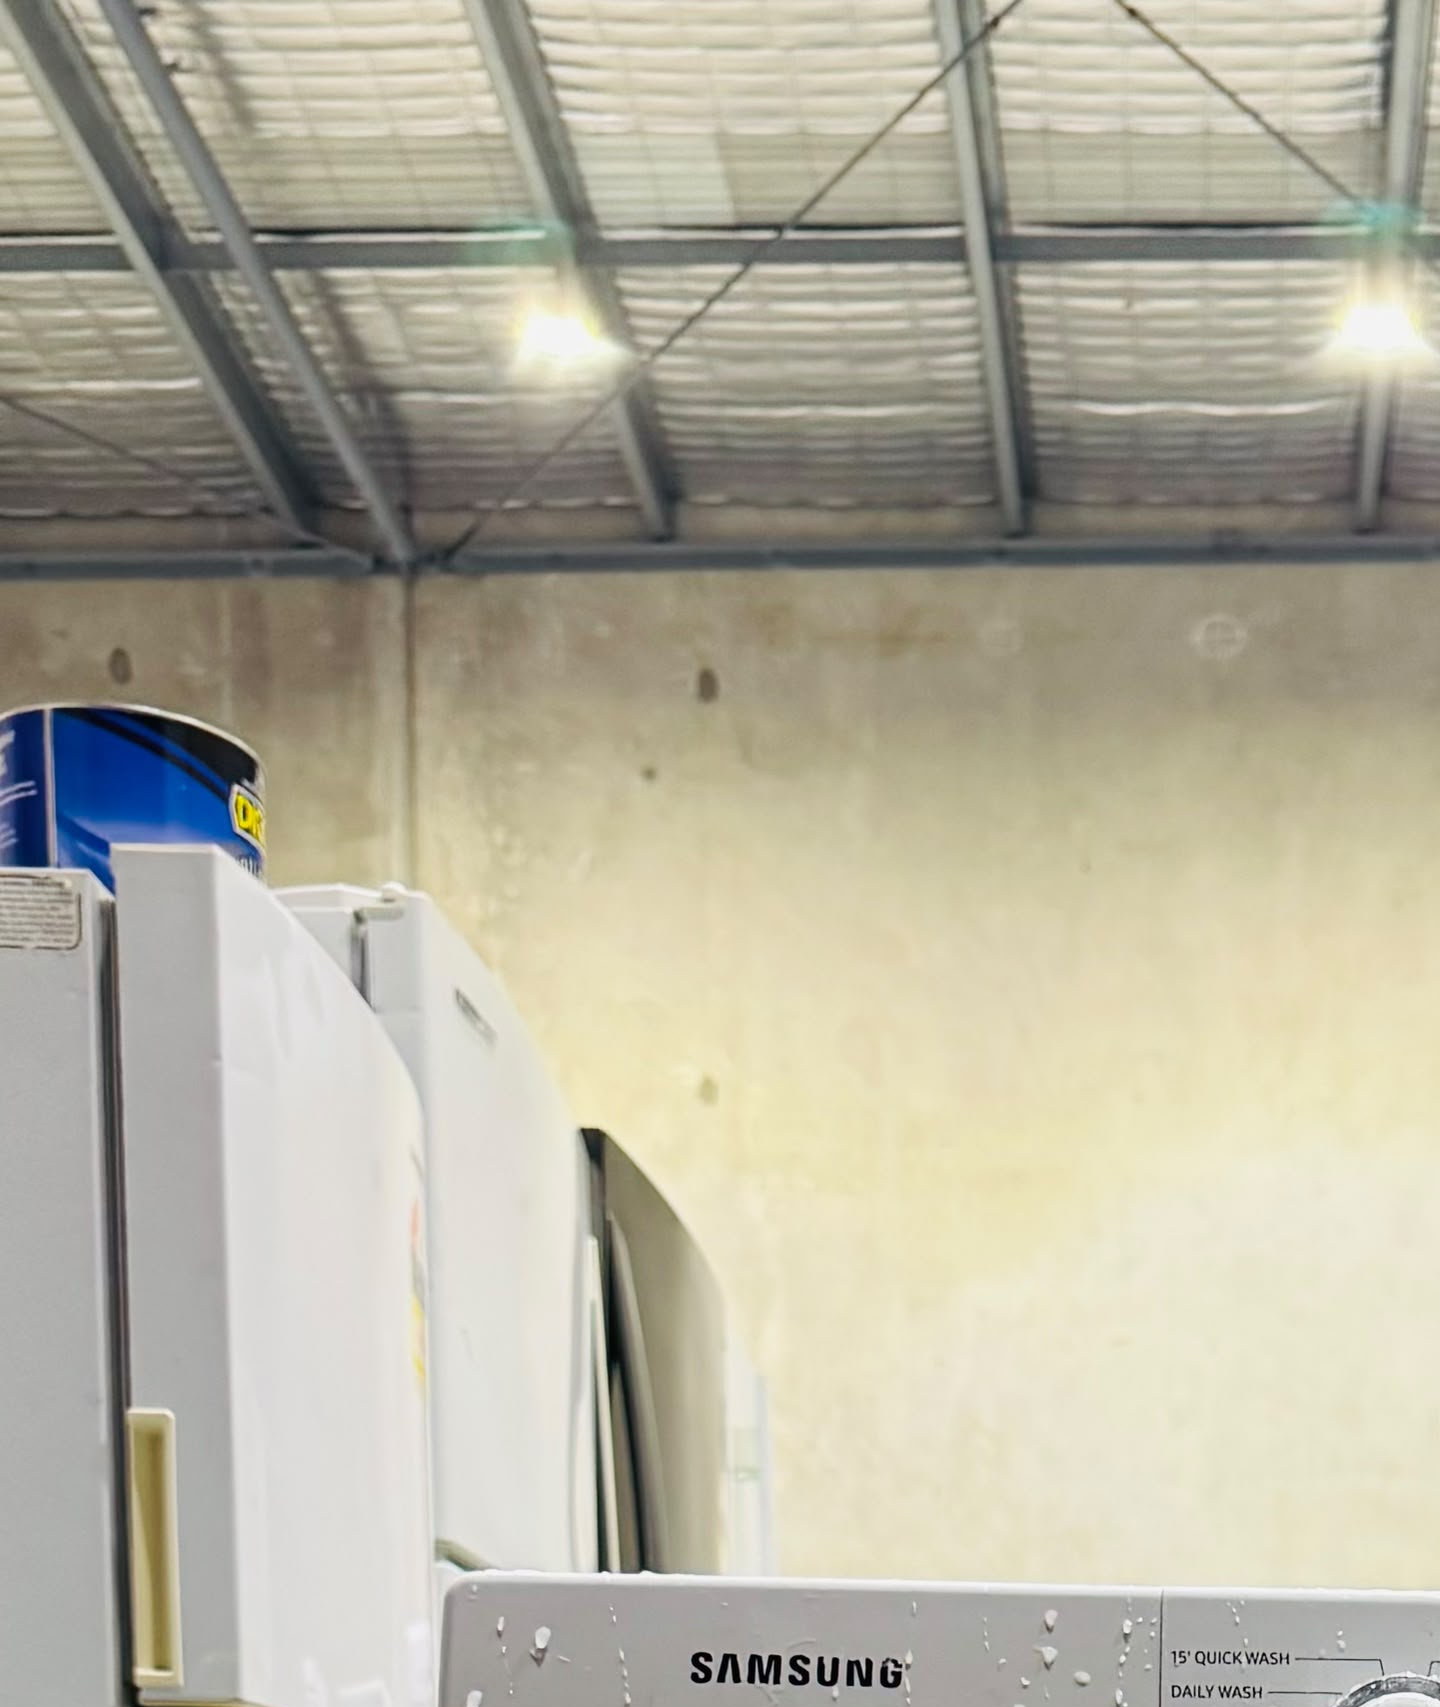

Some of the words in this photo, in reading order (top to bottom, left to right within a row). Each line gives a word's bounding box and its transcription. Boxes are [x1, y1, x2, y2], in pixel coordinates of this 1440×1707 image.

[1194, 1651, 1242, 1665] QUICK
[1245, 1652, 1290, 1665] WASH
[690, 1651, 904, 1689] SAMSUNG
[1171, 1685, 1214, 1698] DAILY
[1218, 1685, 1263, 1698] WASH
